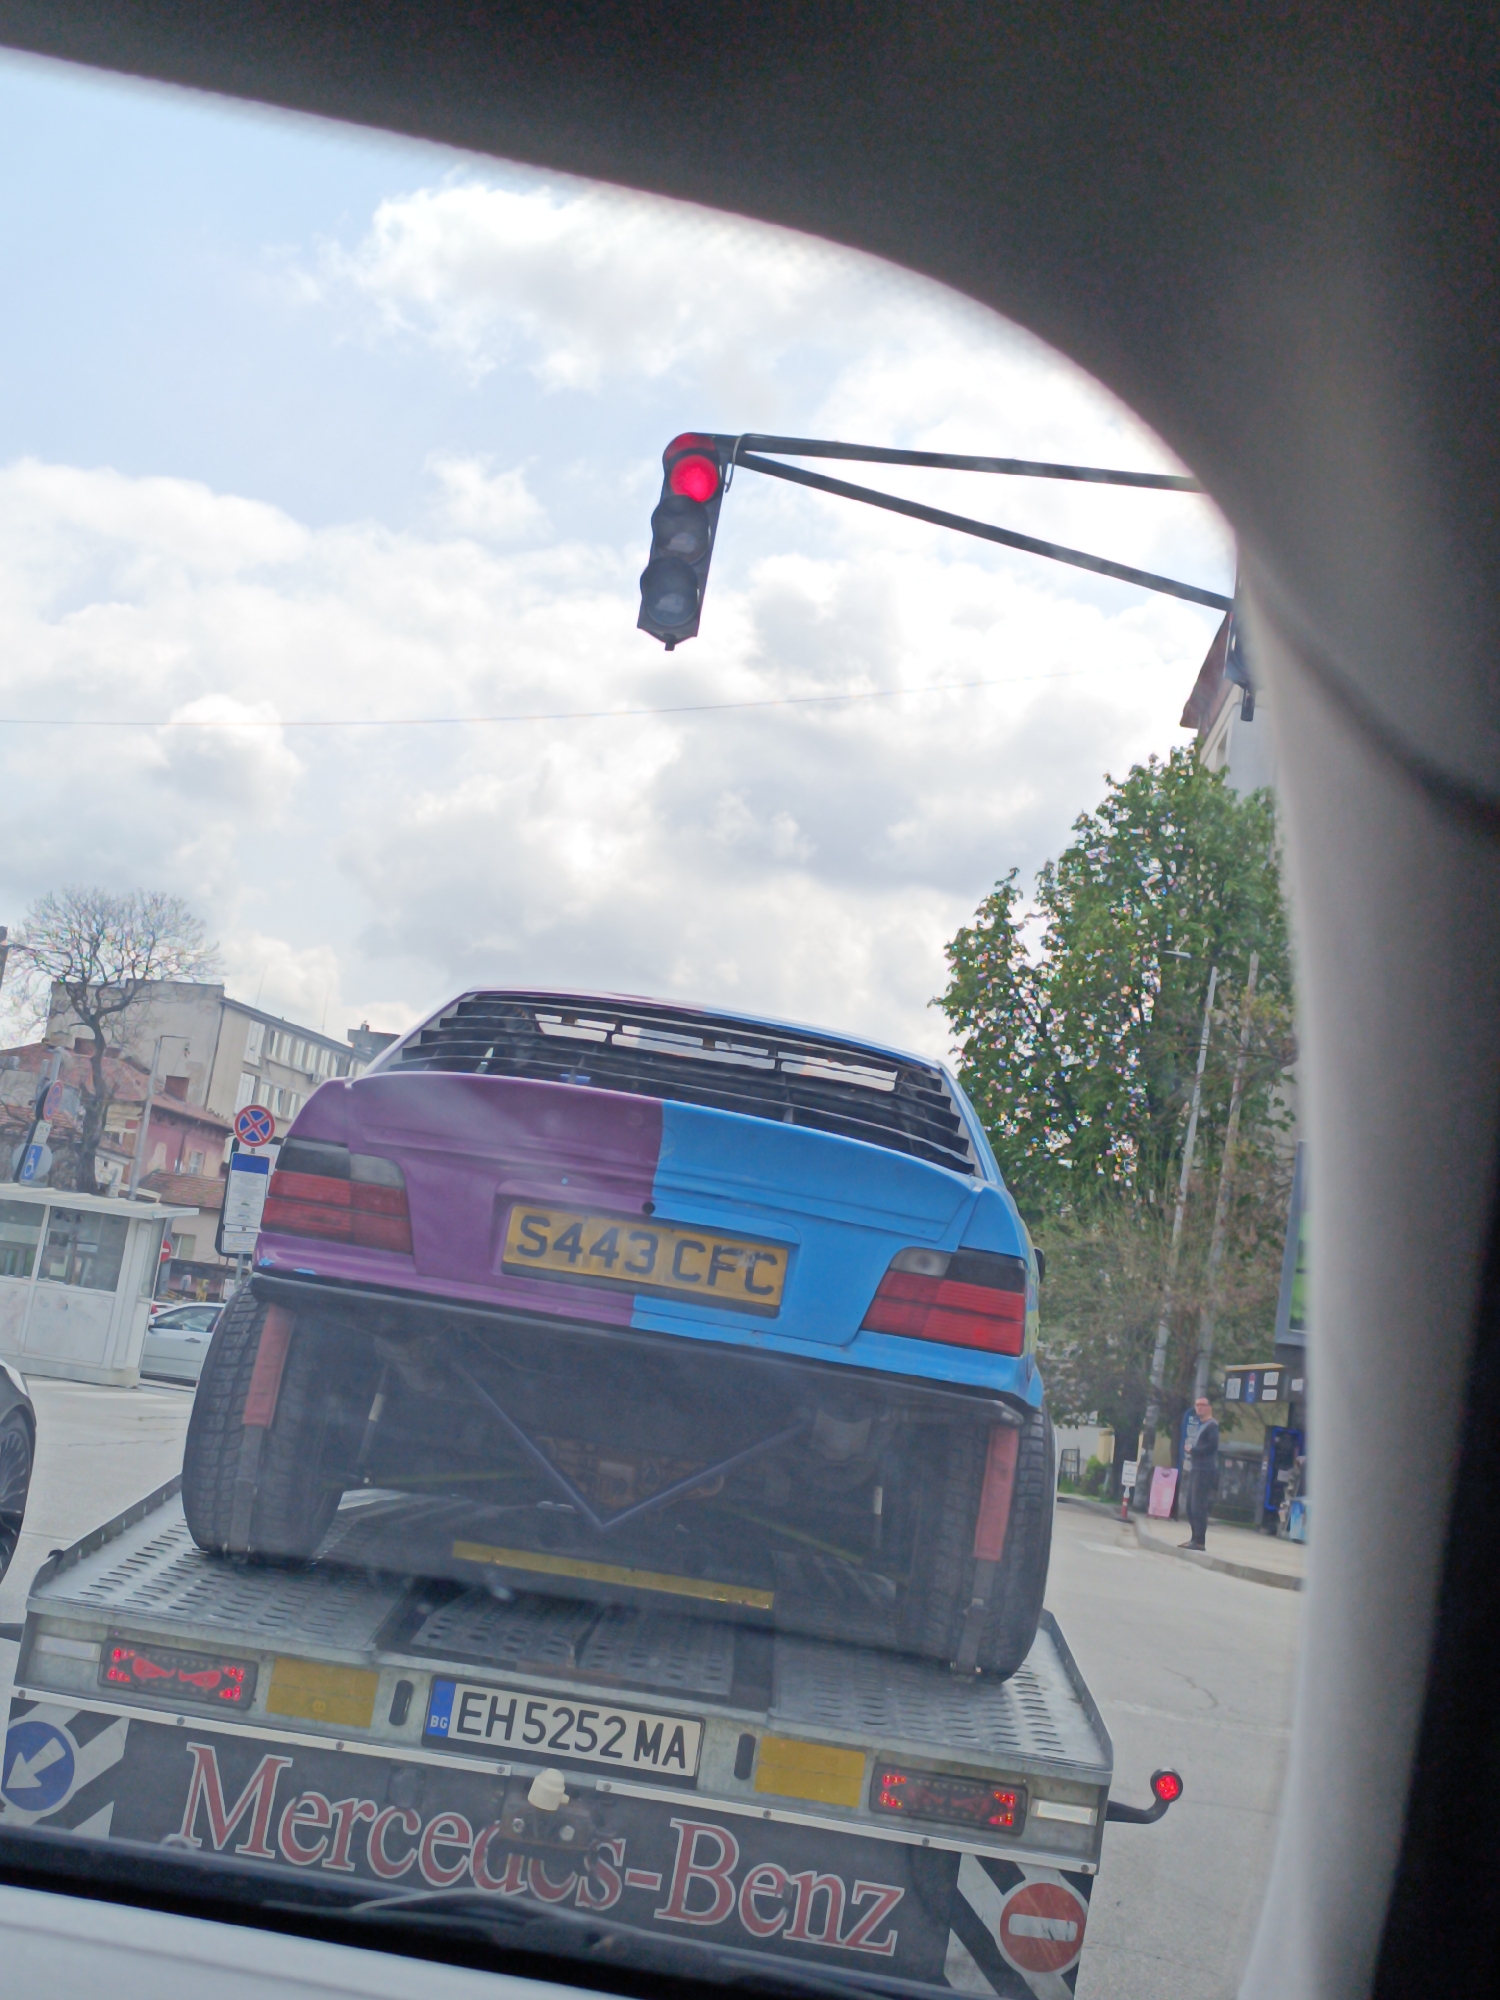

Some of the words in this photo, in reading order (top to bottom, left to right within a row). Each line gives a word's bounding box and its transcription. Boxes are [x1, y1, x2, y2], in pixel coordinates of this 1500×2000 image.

[516, 1215, 659, 1275] S443
[671, 1239, 778, 1296] CFC
[430, 1715, 448, 1729] BG
[456, 1691, 517, 1741] EH
[522, 1701, 627, 1759] 5252
[633, 1719, 686, 1769] MA
